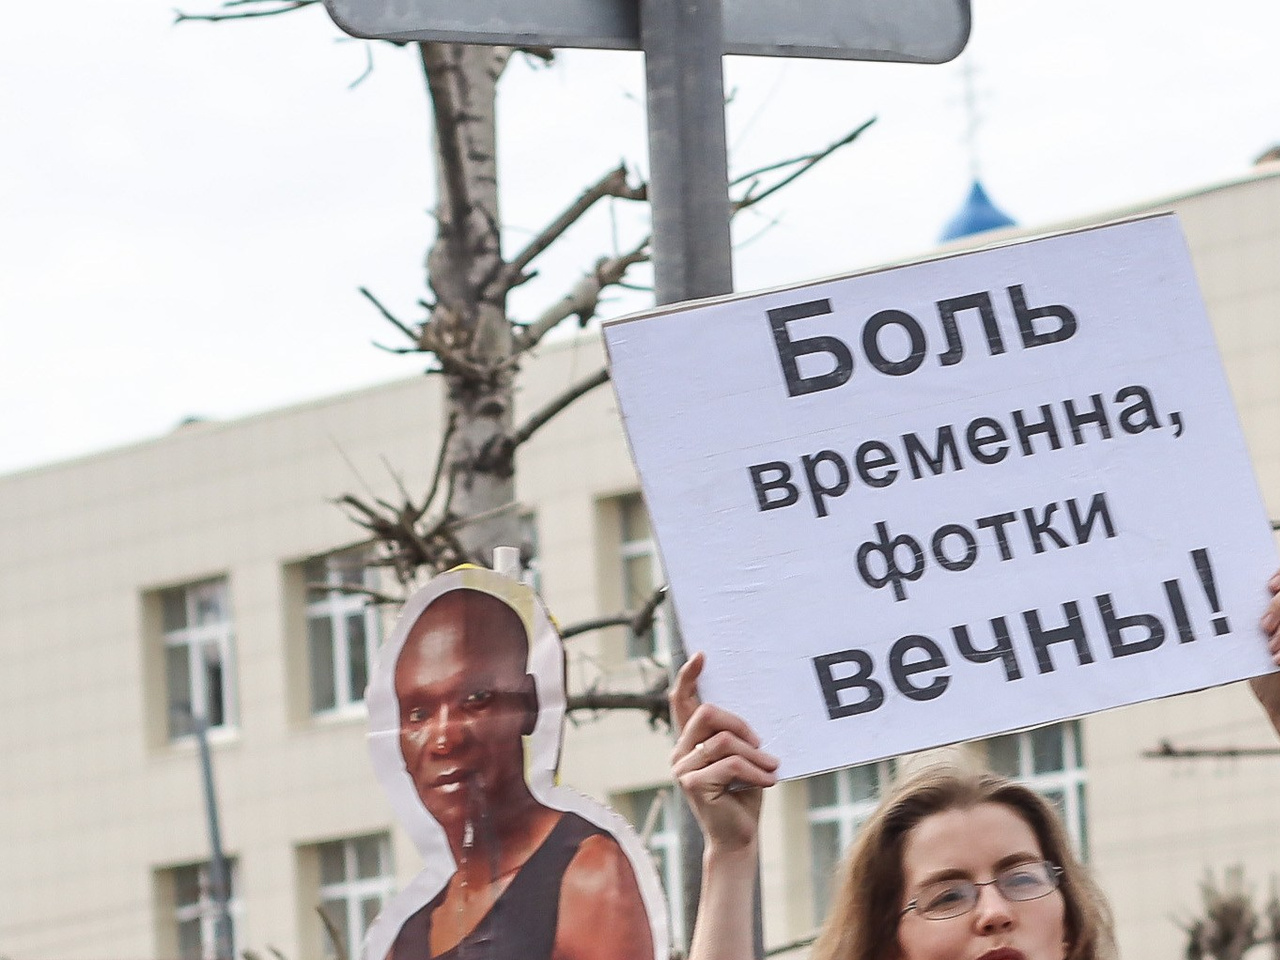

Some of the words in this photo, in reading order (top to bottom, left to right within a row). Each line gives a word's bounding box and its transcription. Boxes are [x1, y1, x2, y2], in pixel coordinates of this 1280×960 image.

[765, 284, 1079, 398] Боль
[748, 385, 1183, 518] временна,
[856, 492, 1117, 602] фотки
[812, 547, 1231, 720] вечны!
